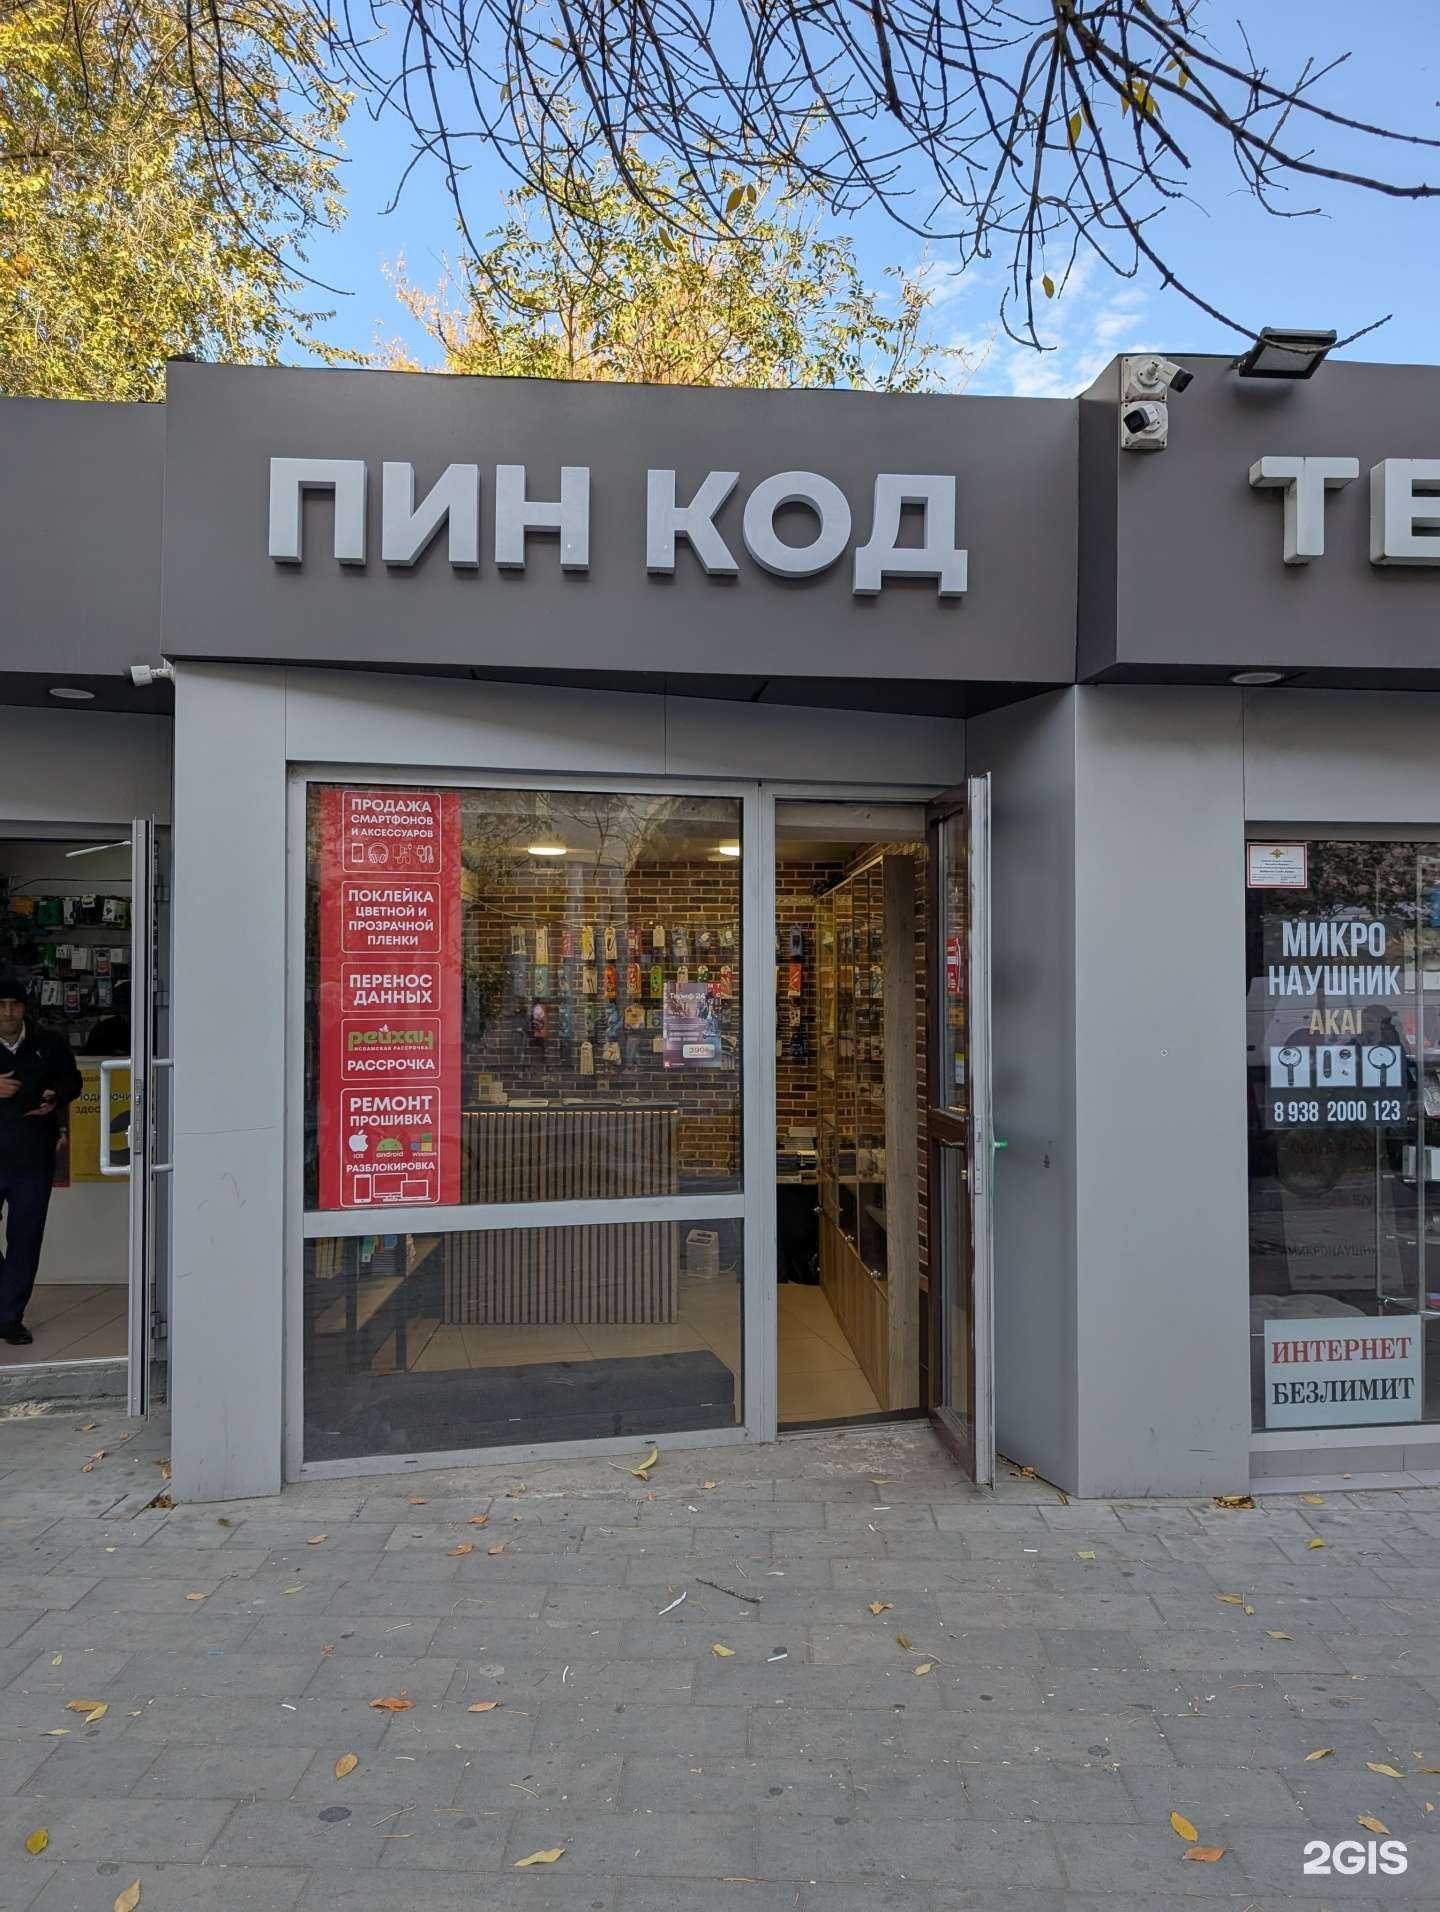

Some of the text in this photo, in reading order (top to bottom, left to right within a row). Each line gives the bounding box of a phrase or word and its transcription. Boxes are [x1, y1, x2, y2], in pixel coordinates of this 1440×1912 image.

[268, 457, 968, 598] ПИН КОД
[351, 799, 432, 813] ПРОДАЖА
[351, 814, 433, 825] СМАРТФОНОВ
[351, 828, 434, 838] И АКСЕССУАРОВ
[348, 888, 434, 903] ПОКЛЕЙКА
[356, 906, 427, 918] ЦВЕТНОЙ И
[349, 920, 434, 931] ПРОЗРАЧНОЙ
[367, 935, 419, 946] ПЛЕНКИ
[1282, 921, 1386, 957] МИКРО
[350, 974, 433, 988] ПЕРЕНОС
[1268, 965, 1401, 996] НАУШНИК
[353, 990, 433, 1005] ДАННЫХ
[347, 1058, 435, 1072] РАССРОЧКА
[350, 1095, 433, 1112] РЕМОНТ
[1274, 1100, 1401, 1122] 8 938 2000 123
[350, 1113, 433, 1127] ПРОШИВКА
[346, 1161, 435, 1174] РАЗБЛОКИРОВКА
[1271, 1337, 1412, 1364] ИНТЕРНЕТ
[1272, 1377, 1415, 1405] БЕЗЛИМИТ
